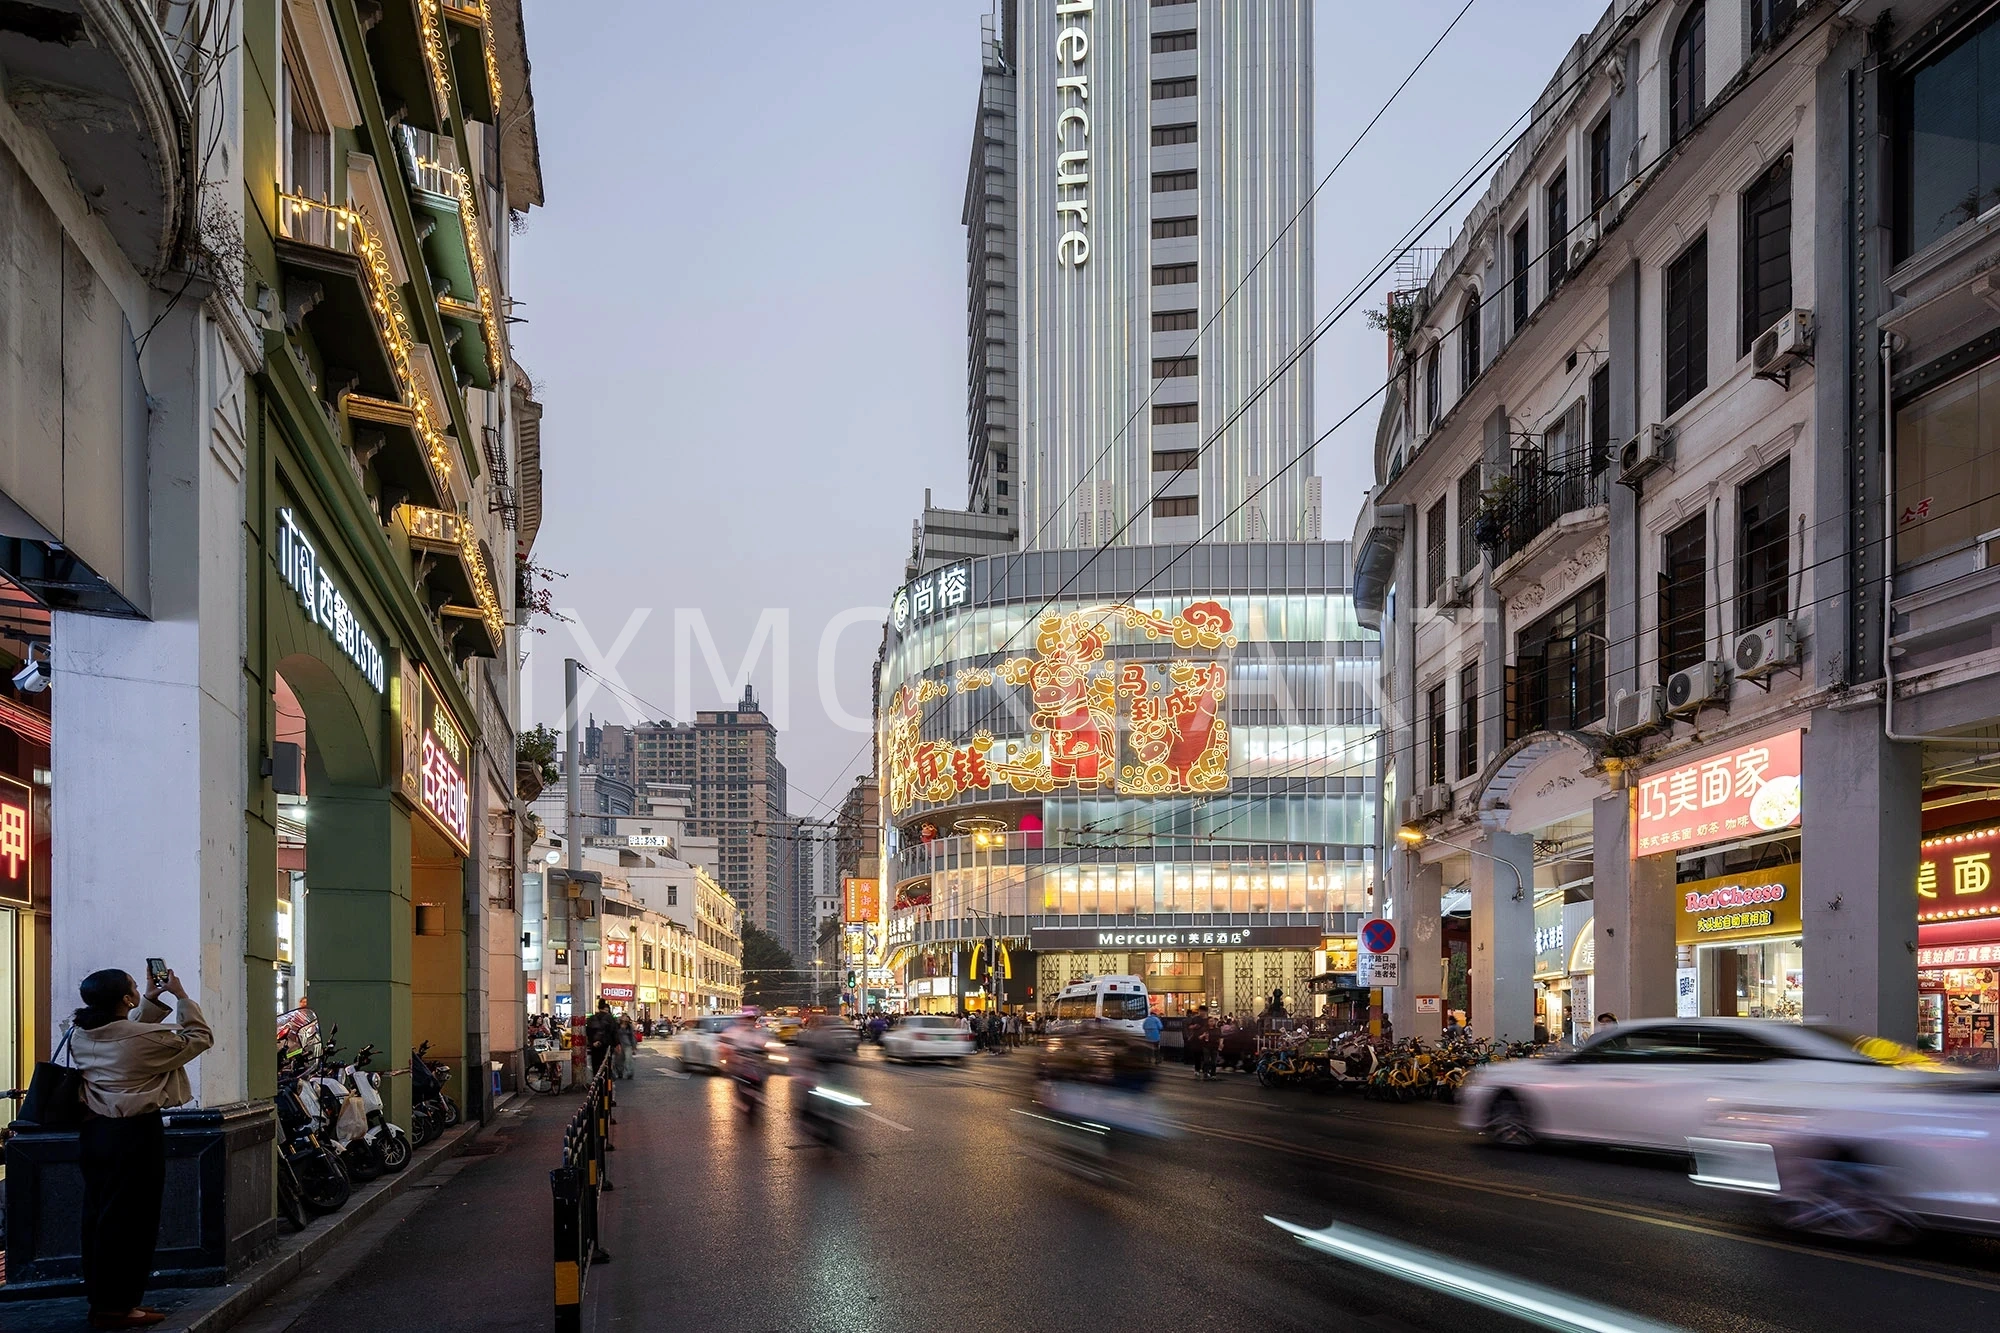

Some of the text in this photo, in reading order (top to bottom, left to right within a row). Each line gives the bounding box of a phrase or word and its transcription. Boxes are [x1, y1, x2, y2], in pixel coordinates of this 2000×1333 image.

[1900, 497, 1934, 526] 소주
[914, 565, 967, 620] 尚榕
[347, 609, 385, 694] BISTRO
[422, 728, 469, 846] 名表回收
[1640, 747, 1770, 821] 巧美面家
[1696, 821, 1720, 836] 奶茶
[1725, 814, 1750, 830] 咖啡
[1685, 884, 1784, 912] RedCheese
[1098, 932, 1178, 945] Mercure
[1188, 932, 1242, 945] 美居酒店
